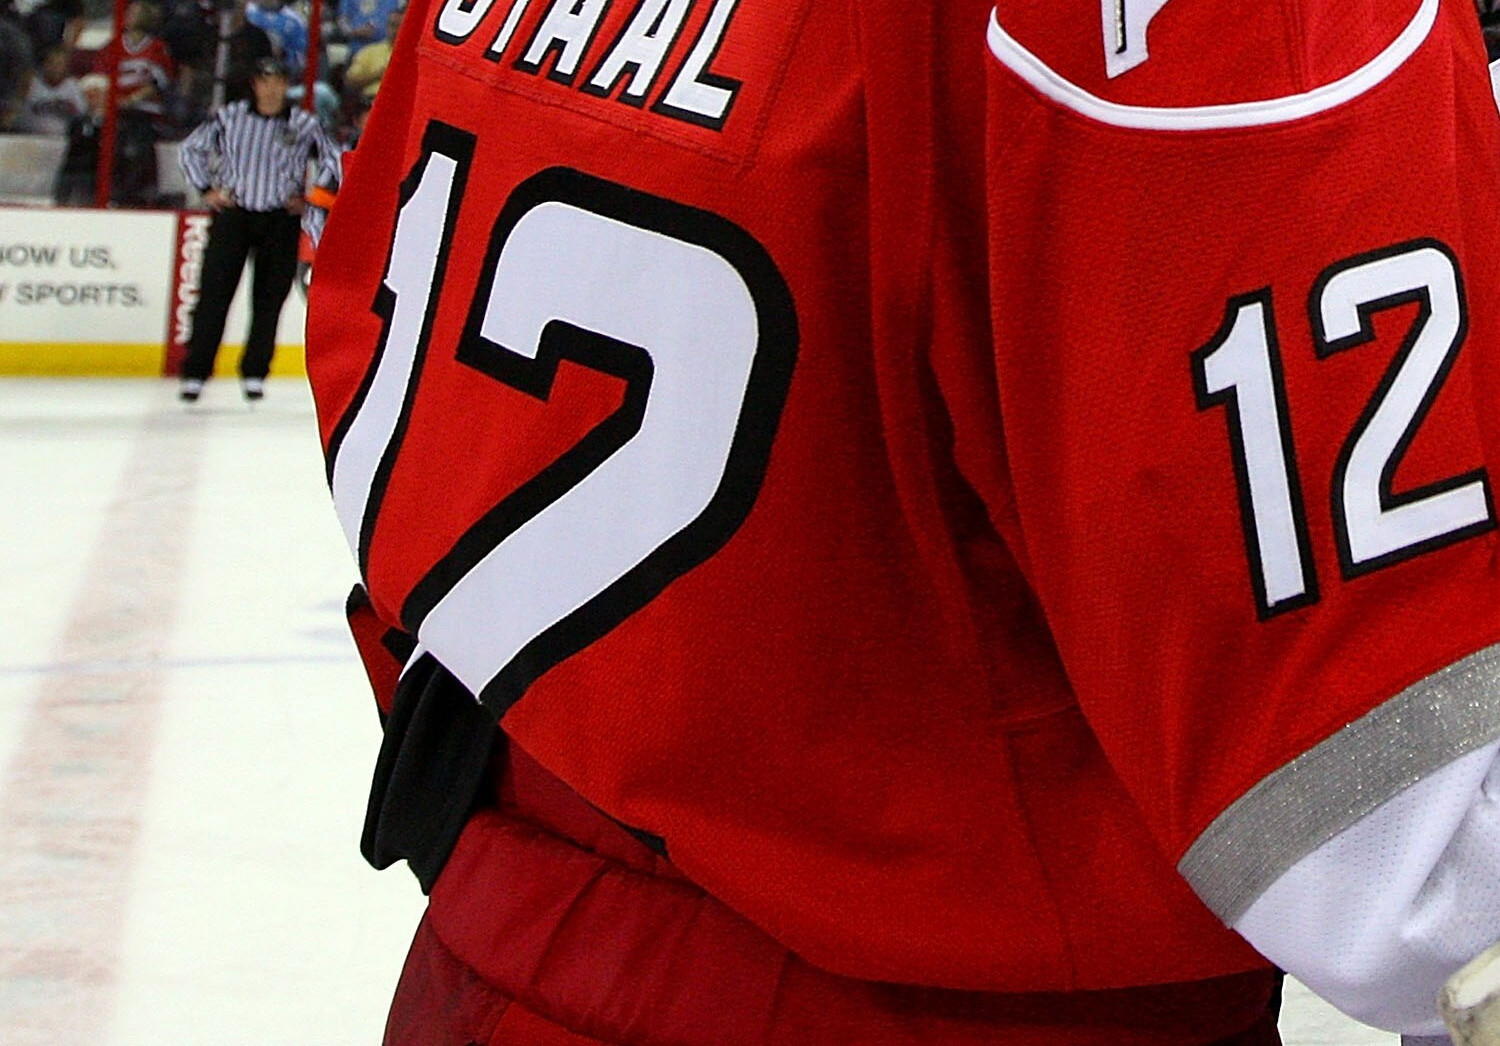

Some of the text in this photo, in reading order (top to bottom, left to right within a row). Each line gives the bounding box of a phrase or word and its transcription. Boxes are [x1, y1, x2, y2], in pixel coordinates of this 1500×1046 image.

[0, 245, 118, 269] OW US.
[17, 283, 145, 308] SPORTS.
[325, 118, 799, 722] 12
[1193, 236, 1500, 621] 12
